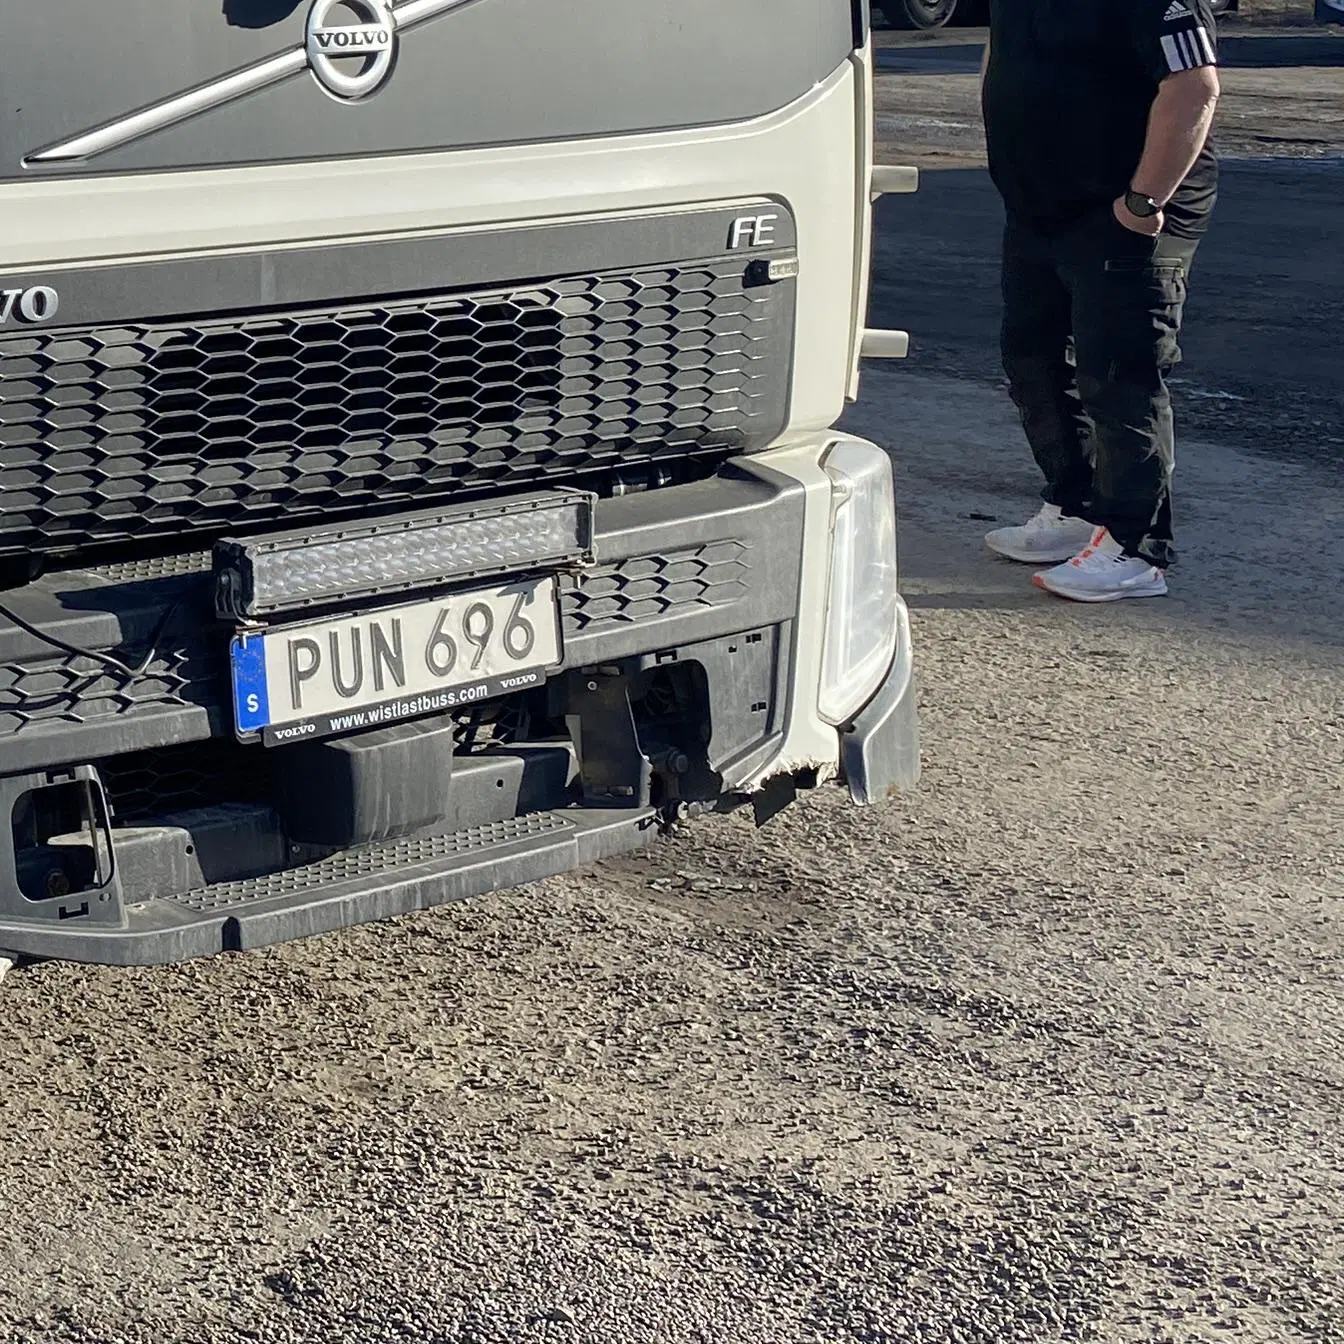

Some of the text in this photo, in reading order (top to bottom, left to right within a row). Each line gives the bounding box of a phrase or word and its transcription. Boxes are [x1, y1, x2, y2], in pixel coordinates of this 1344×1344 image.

[312, 30, 389, 48] VOLVO
[731, 214, 778, 249] FE
[287, 591, 535, 710] PUN 696
[246, 693, 259, 713] S
[273, 673, 538, 740] VOLVO www.wistlastbuss.com VOLVO
